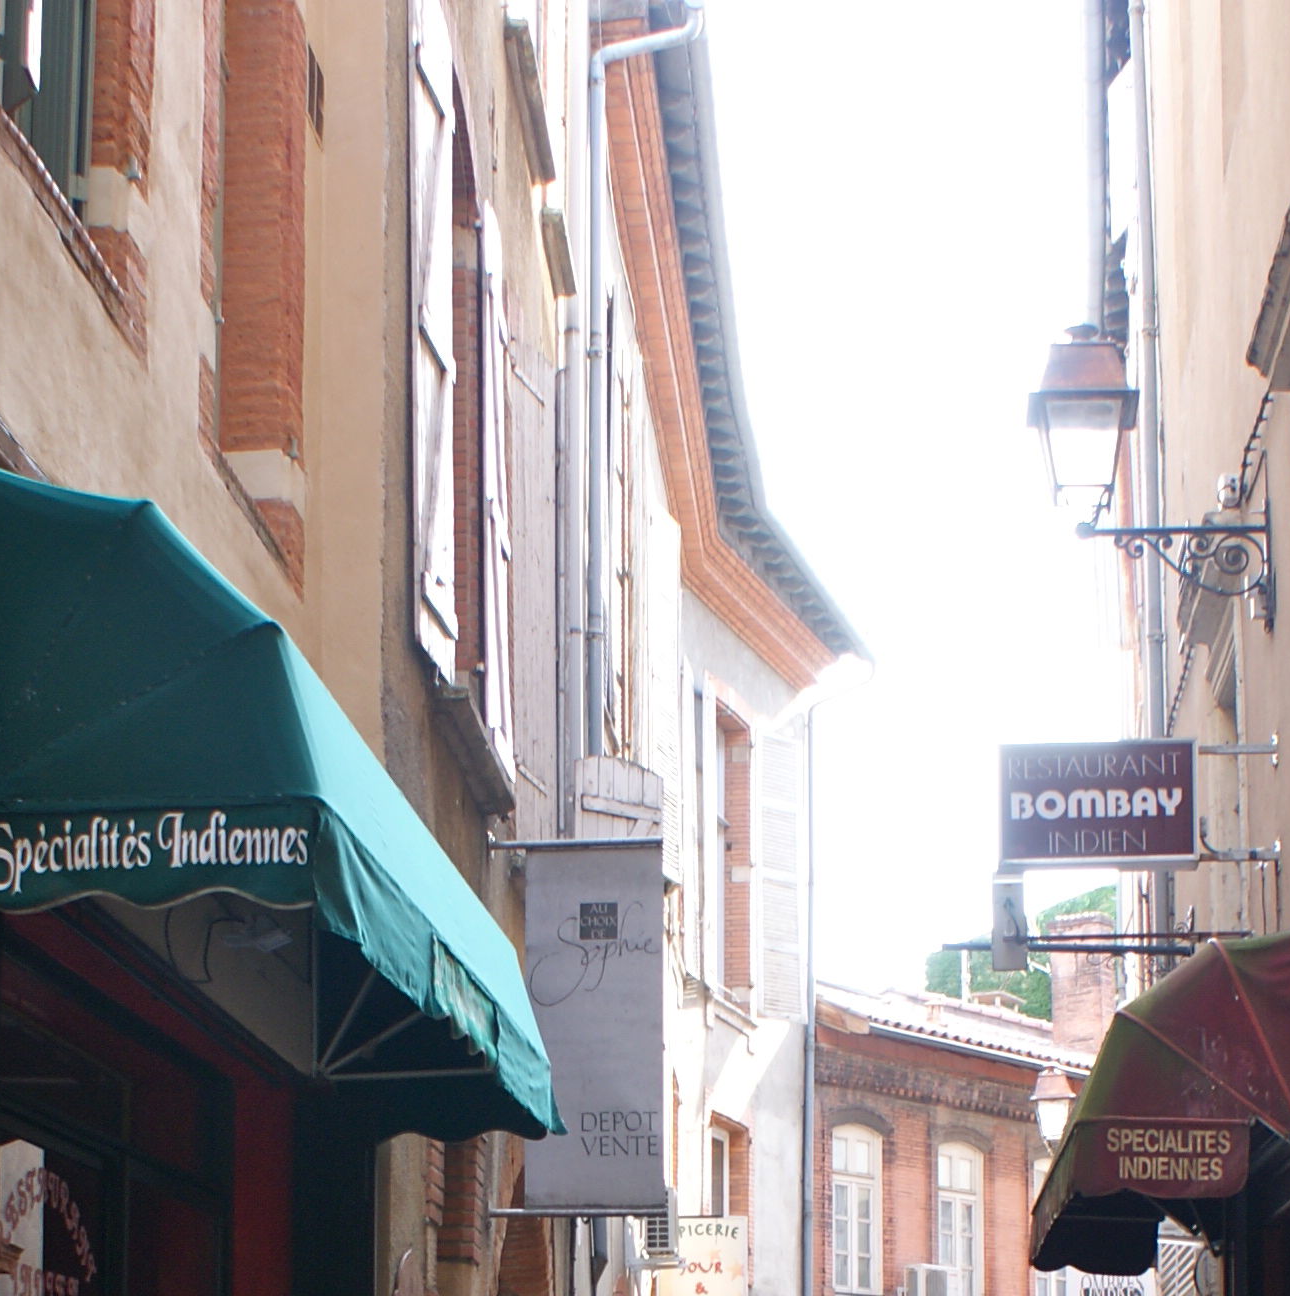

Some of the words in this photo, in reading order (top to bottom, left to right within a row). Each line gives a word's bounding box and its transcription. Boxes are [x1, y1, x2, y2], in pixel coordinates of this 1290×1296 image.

[1008, 752, 1181, 780] RESTAURANT
[1010, 787, 1183, 820] BOMBAY
[158, 809, 309, 868] Indiennes
[1048, 828, 1147, 854] INDIEN
[589, 903, 608, 914] AU
[580, 916, 617, 927] CHOIX
[590, 928, 606, 939] DE
[529, 900, 659, 1007] Sophie
[580, 1111, 658, 1132] DEPOT
[580, 1135, 659, 1156] VENTE
[1106, 1128, 1232, 1154] SPECIALITES
[1118, 1156, 1224, 1180] INDIENNES
[677, 1223, 740, 1240] PICERIE
[694, 1281, 709, 1295] &
